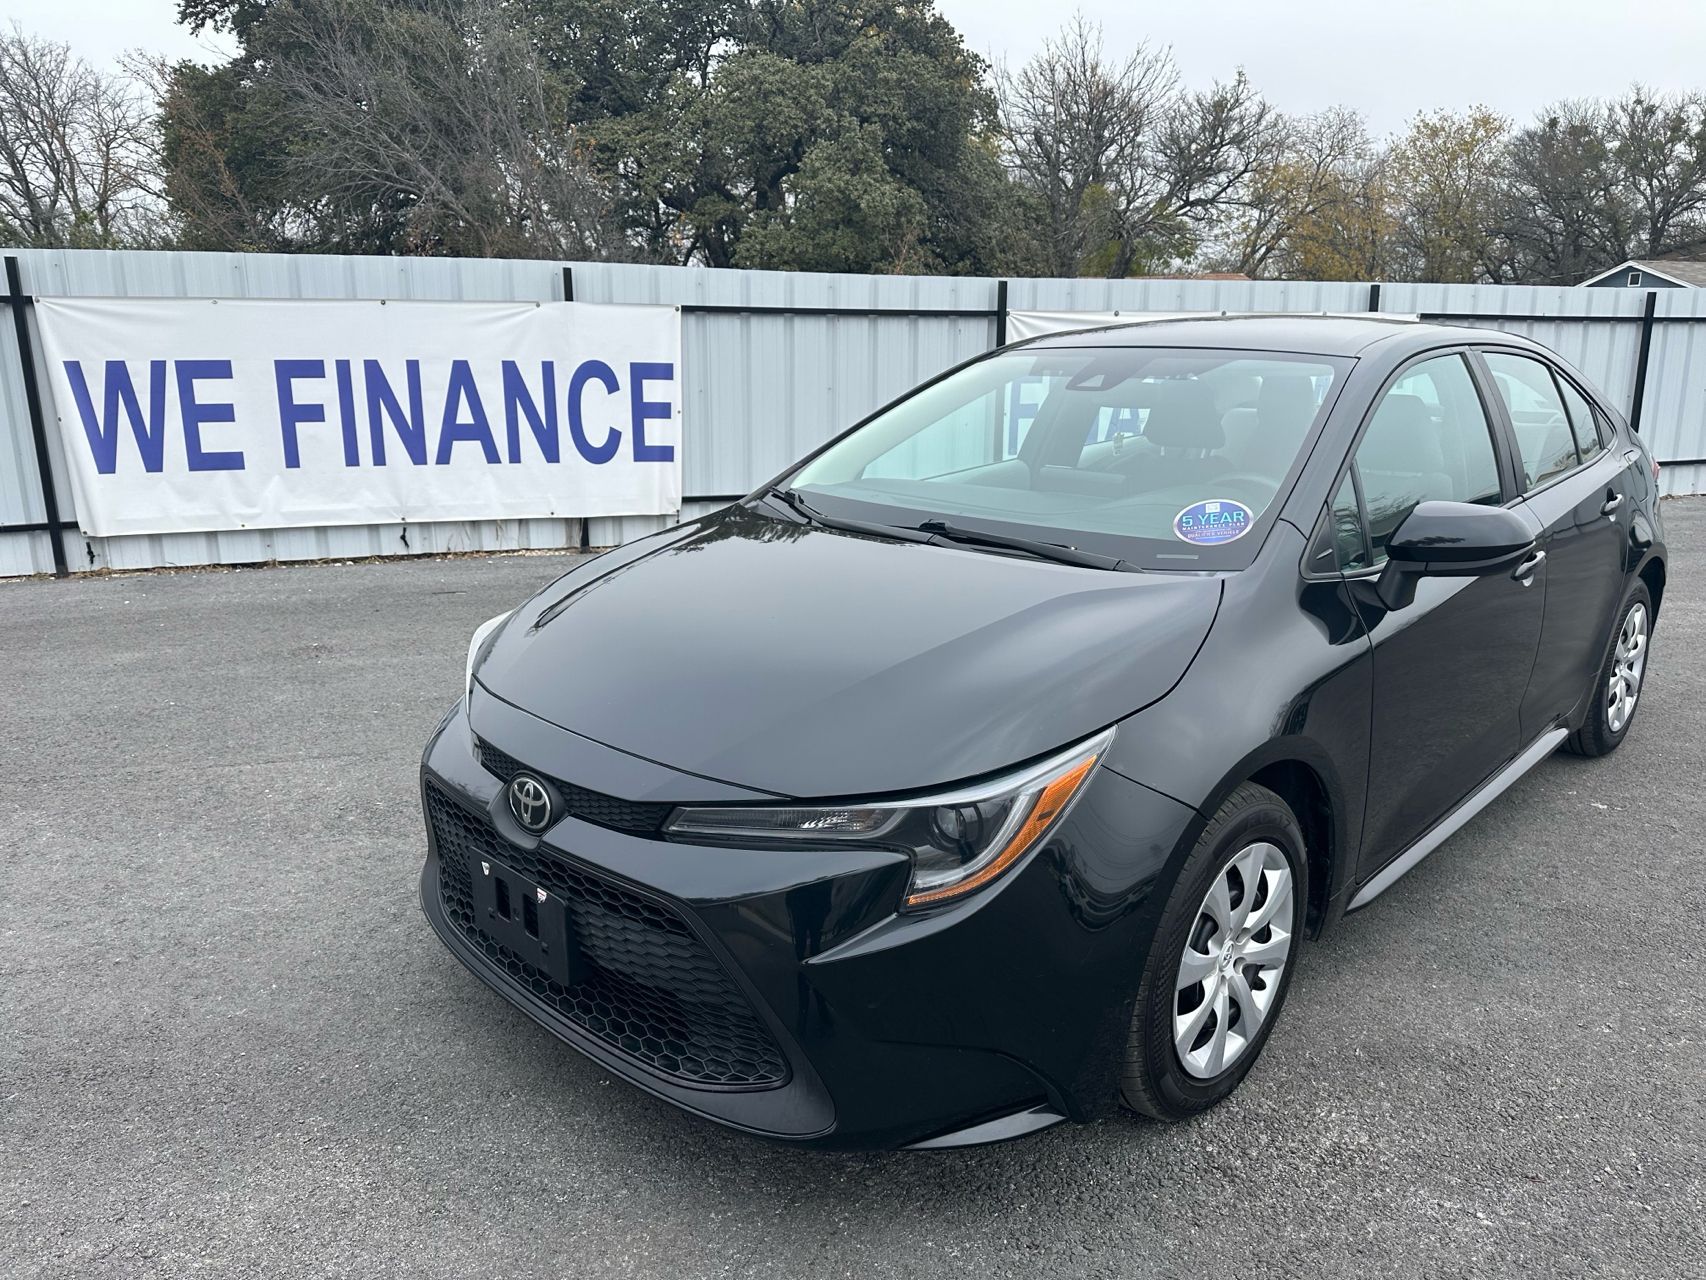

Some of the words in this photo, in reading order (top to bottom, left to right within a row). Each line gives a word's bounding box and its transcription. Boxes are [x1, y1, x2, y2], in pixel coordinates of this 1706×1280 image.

[63, 359, 246, 474] WE
[274, 358, 675, 468] FINANCE
[1182, 515, 1193, 527] 5
[1198, 511, 1245, 525] YEAR
